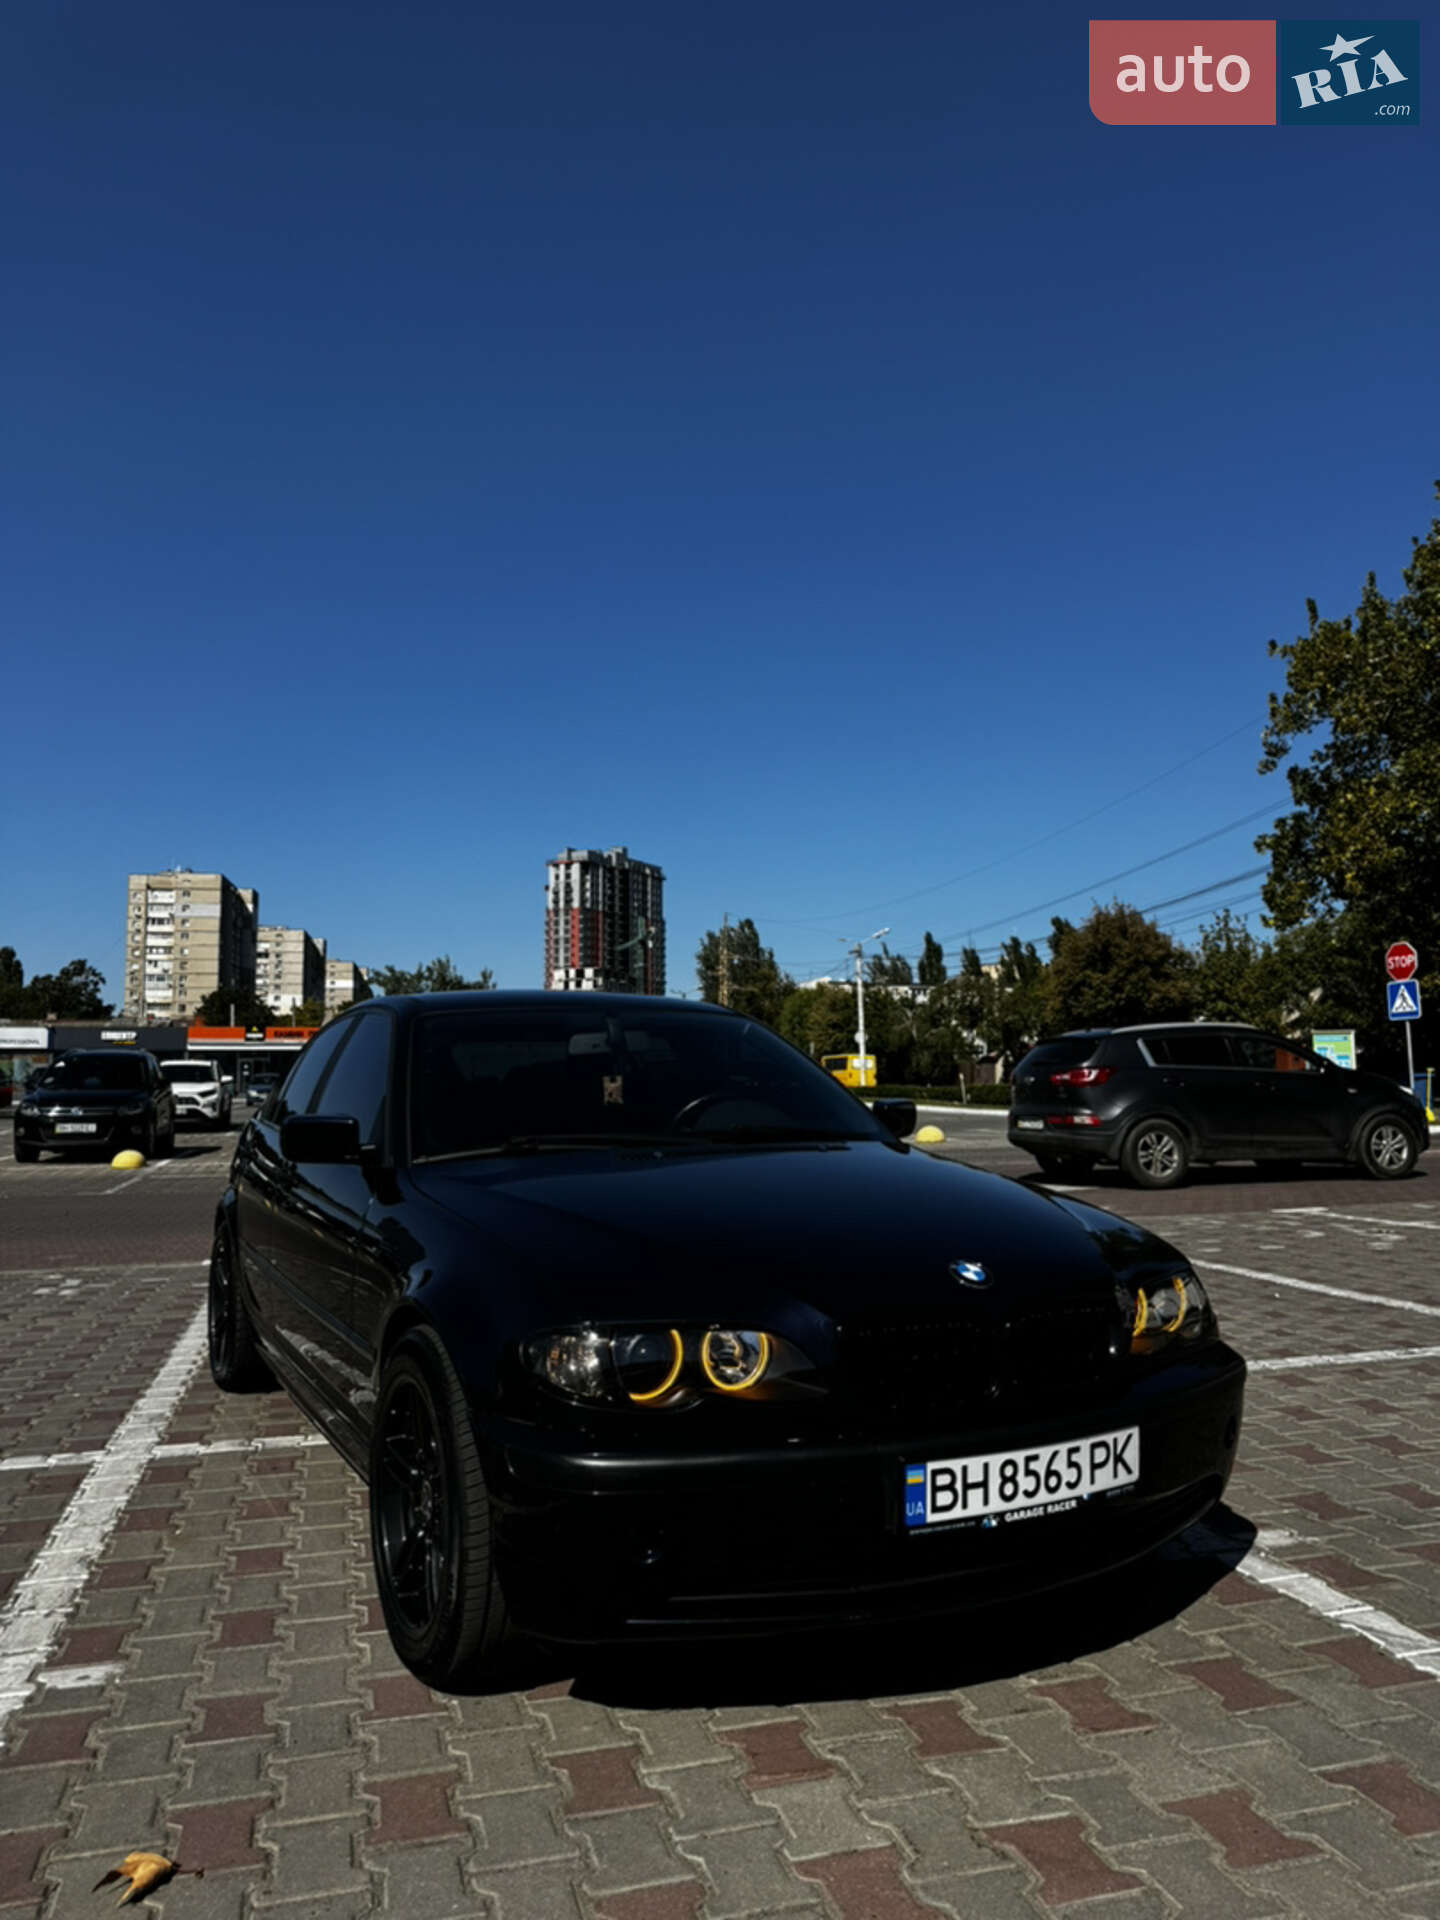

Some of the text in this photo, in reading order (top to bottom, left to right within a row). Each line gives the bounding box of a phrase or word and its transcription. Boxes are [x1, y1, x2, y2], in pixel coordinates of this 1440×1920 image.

[1387, 954, 1415, 969] STOP
[930, 1433, 1133, 1514] BH 8565 PK
[906, 1501, 925, 1516] UA
